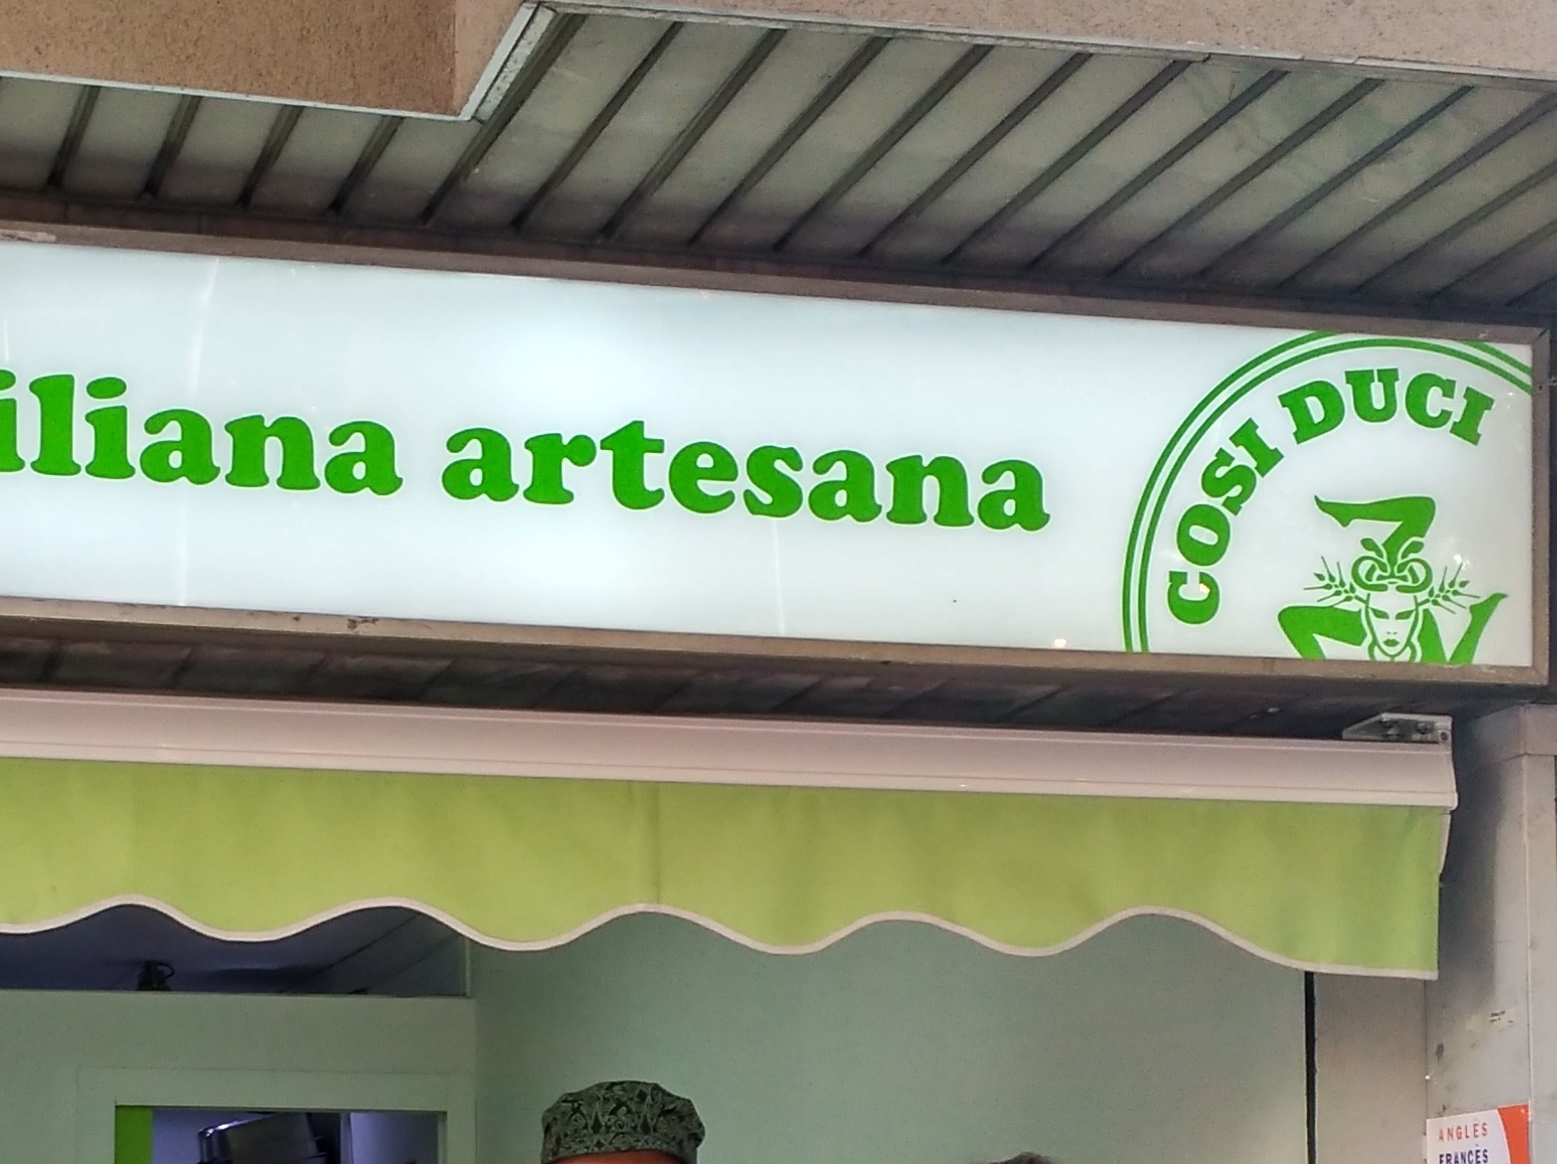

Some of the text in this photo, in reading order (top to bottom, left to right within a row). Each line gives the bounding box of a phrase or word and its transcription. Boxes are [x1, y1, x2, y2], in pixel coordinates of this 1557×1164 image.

[442, 420, 1050, 531] artesana
[1167, 368, 1495, 625] COSI DUCI
[1438, 1118, 1488, 1141] ANGLÈS
